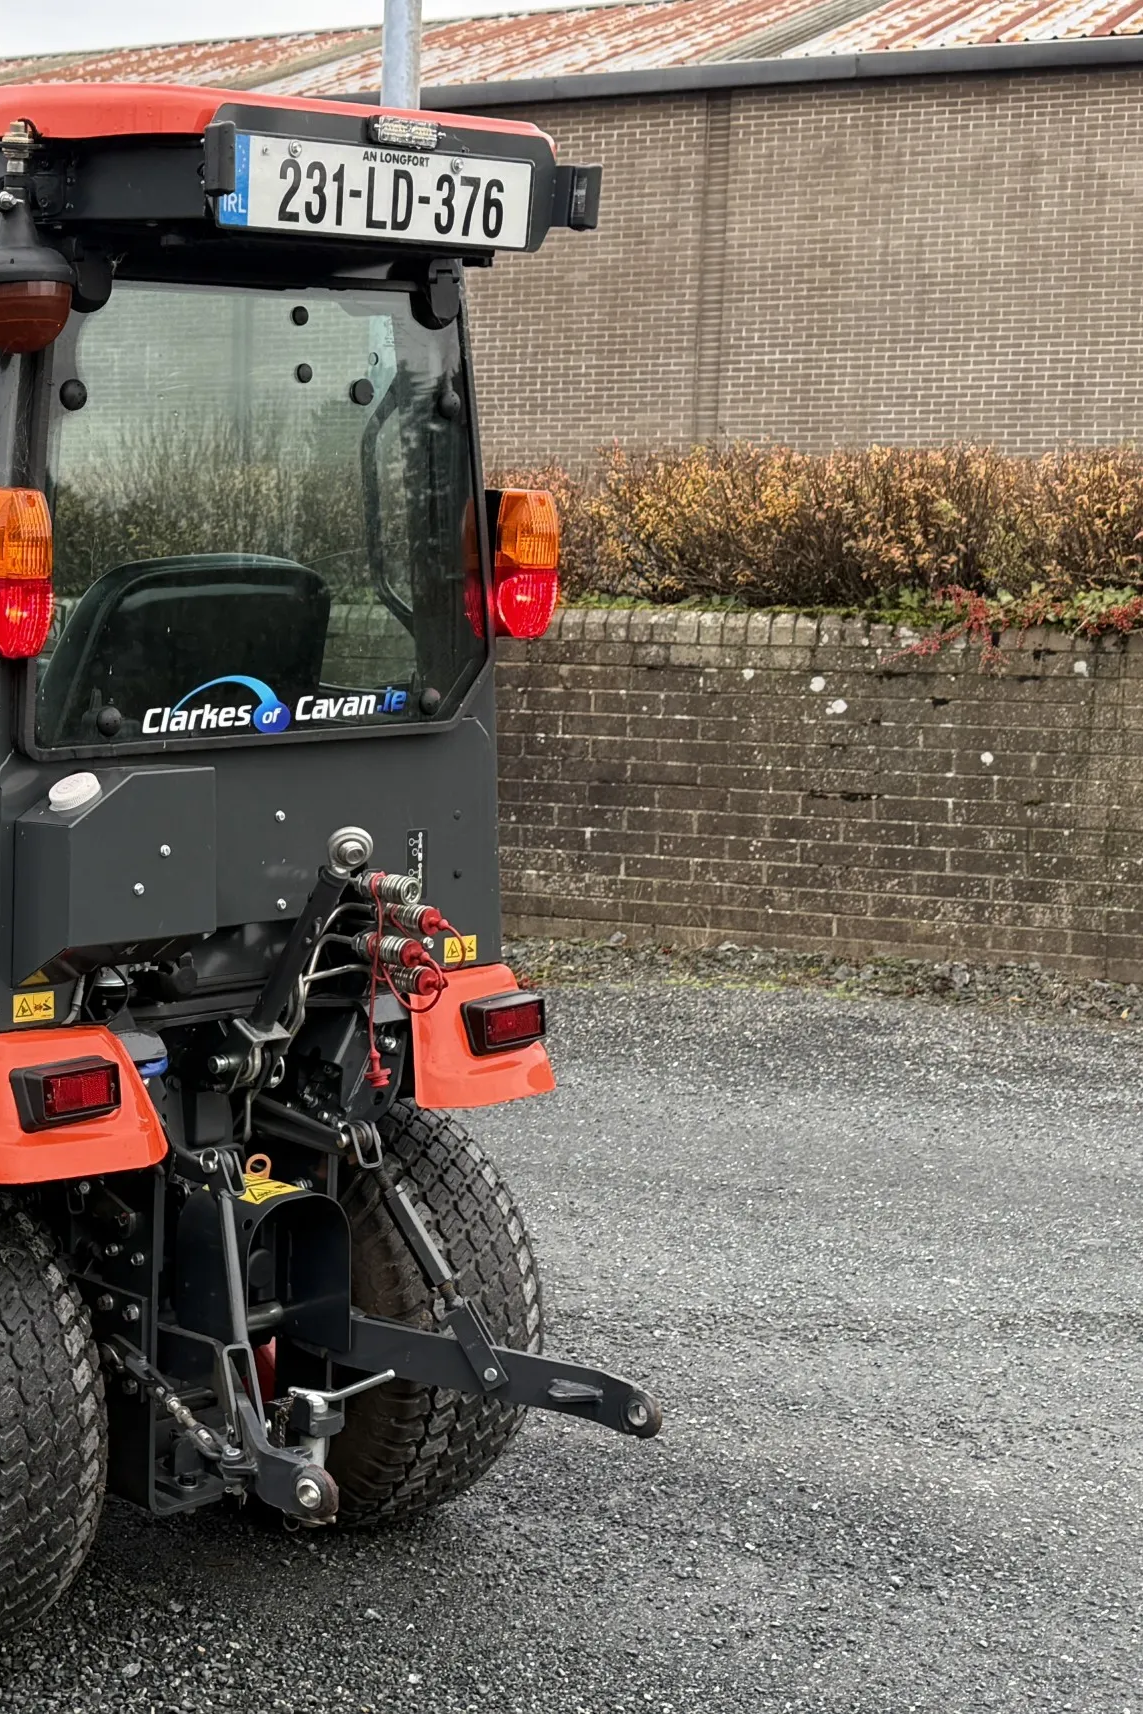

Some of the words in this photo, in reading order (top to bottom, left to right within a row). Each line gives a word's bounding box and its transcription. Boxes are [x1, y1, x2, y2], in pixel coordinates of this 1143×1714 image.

[363, 150, 377, 162] AN
[380, 153, 430, 168] LONGFORT
[223, 192, 247, 214] IRL
[277, 158, 505, 239] 231-LD-376
[142, 703, 252, 734] Clarkes
[261, 707, 282, 724] of
